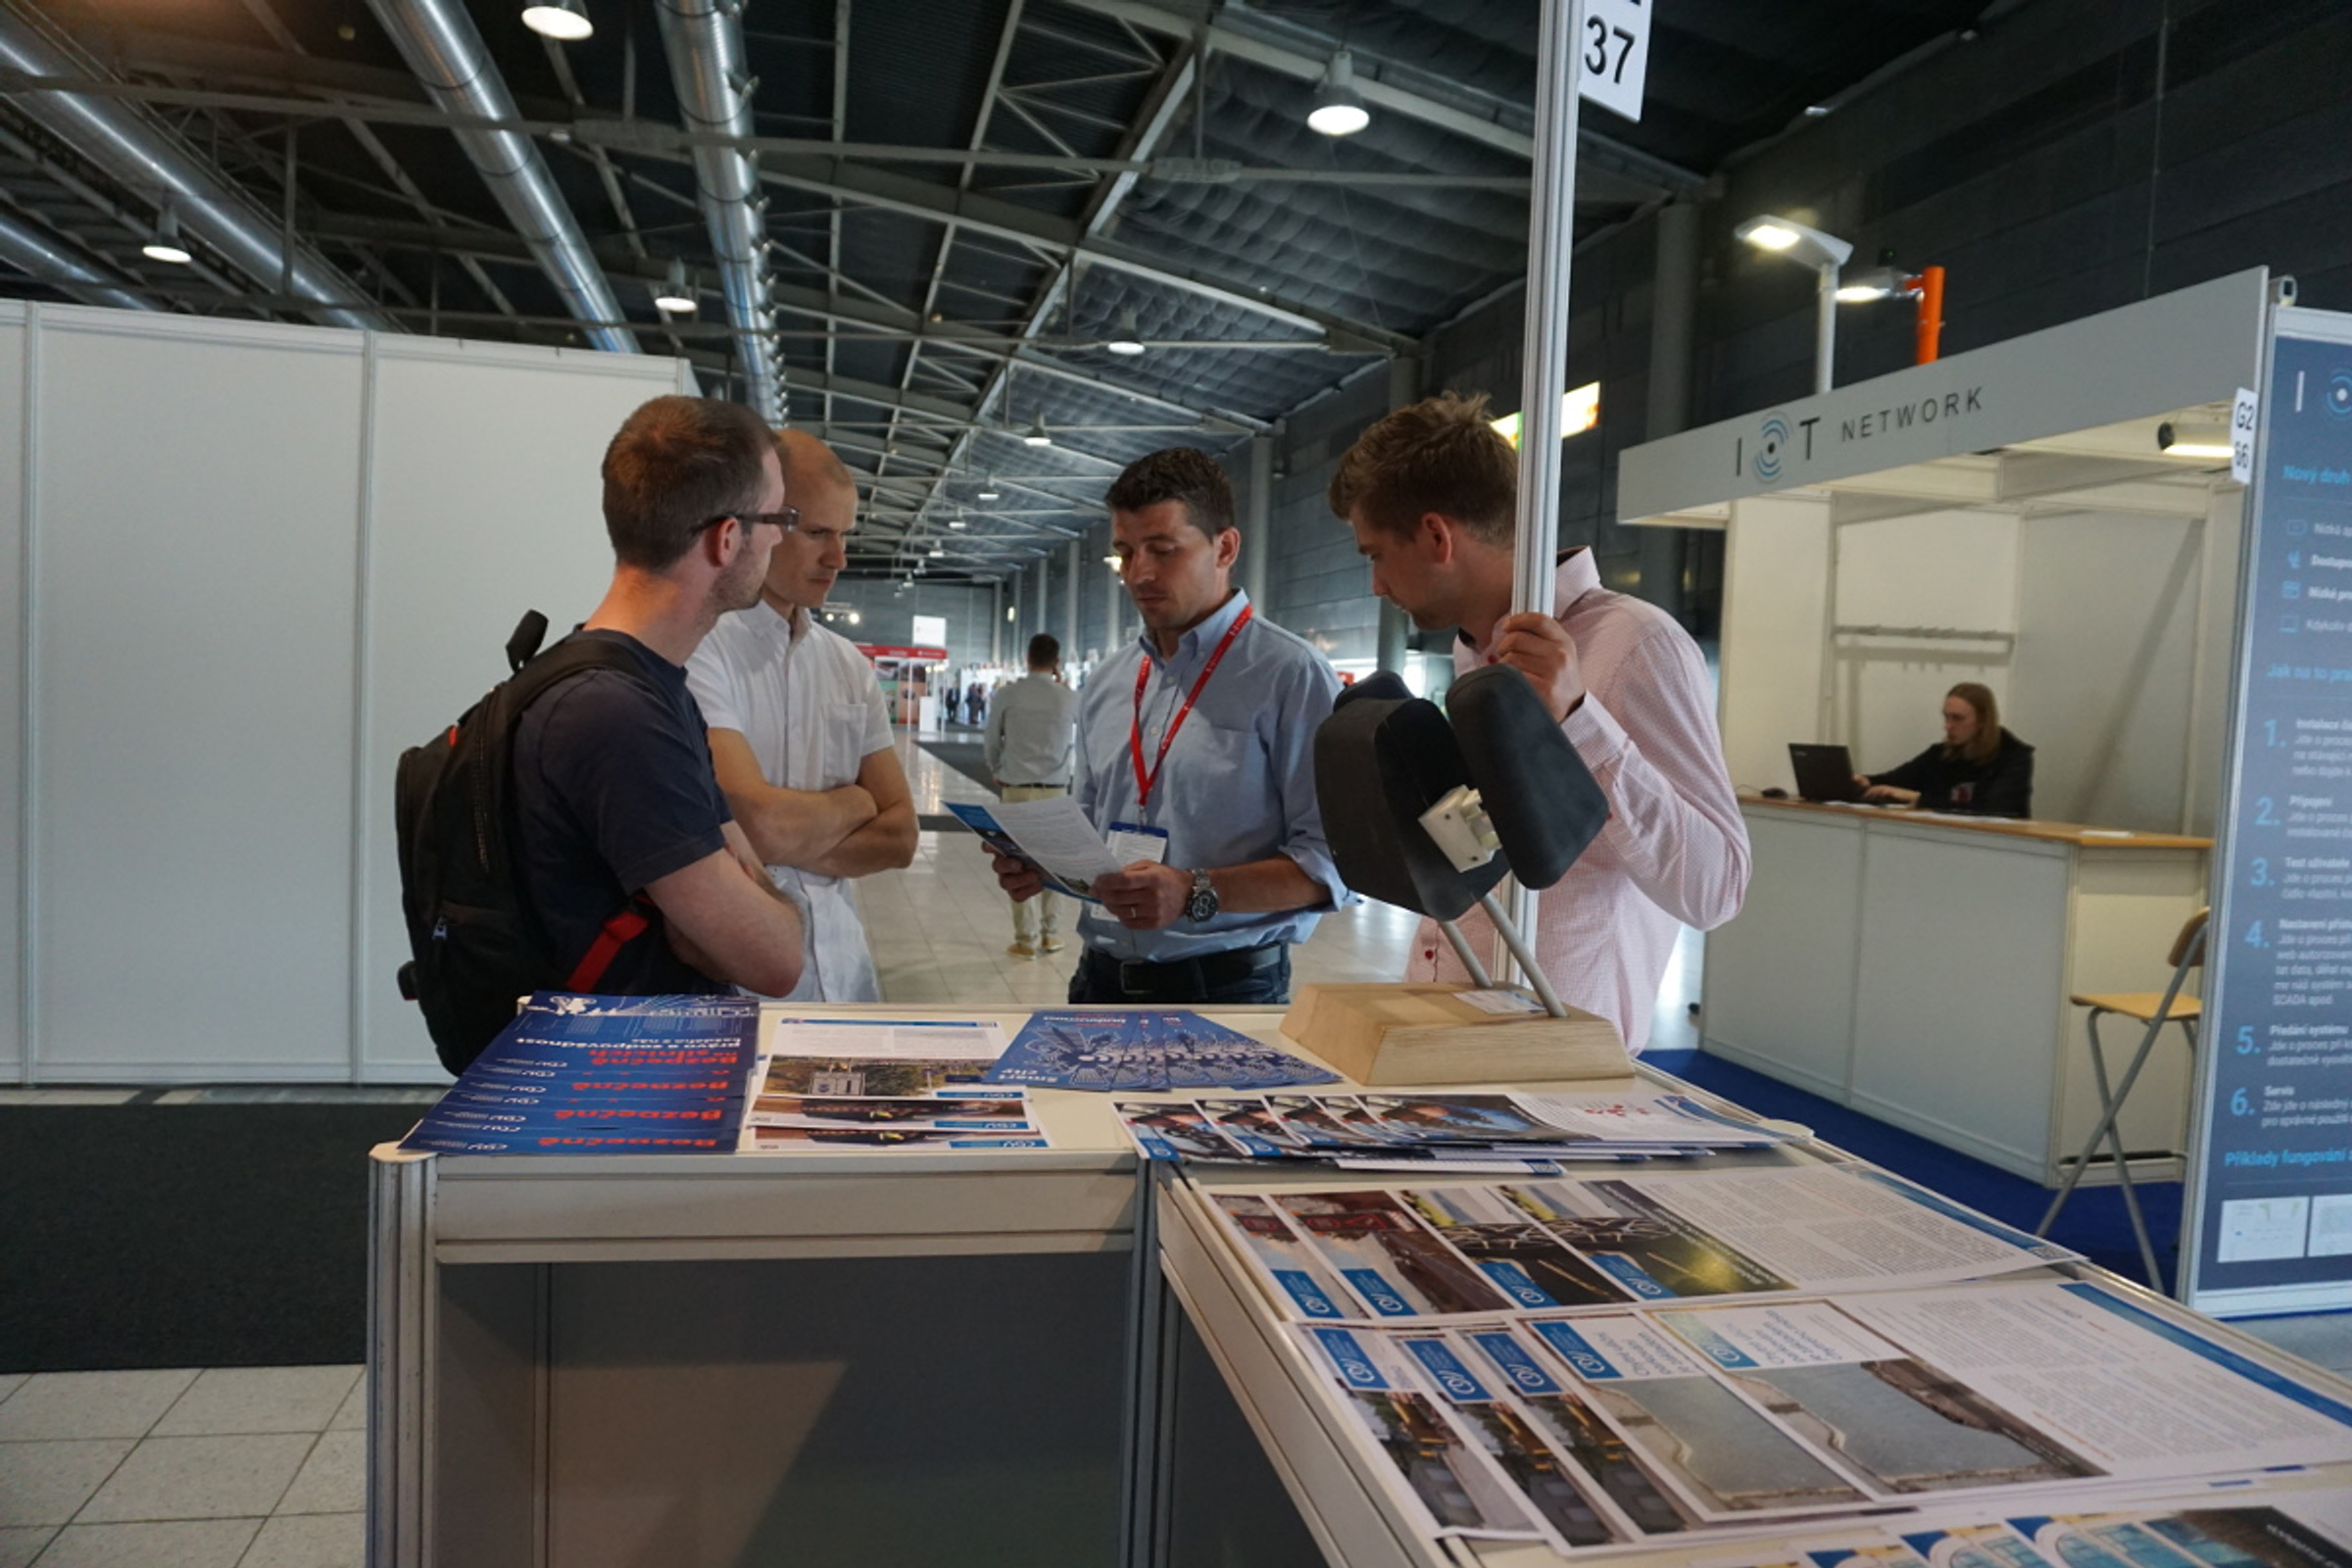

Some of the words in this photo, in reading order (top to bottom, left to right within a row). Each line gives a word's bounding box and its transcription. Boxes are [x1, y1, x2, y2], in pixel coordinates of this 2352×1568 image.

[1585, 15, 1636, 84] 37
[1841, 387, 1984, 443] NETWORK
[2236, 401, 2254, 430] G2
[2264, 718, 2287, 748] 1.
[2256, 797, 2281, 826] 2.
[2251, 857, 2276, 886] 3.
[2244, 919, 2270, 948] 4.
[2236, 1025, 2261, 1054] 5.
[2230, 1087, 2256, 1116] 6.
[2225, 1151, 2279, 1168] Příklady
[2281, 1147, 2348, 1167] fungování
